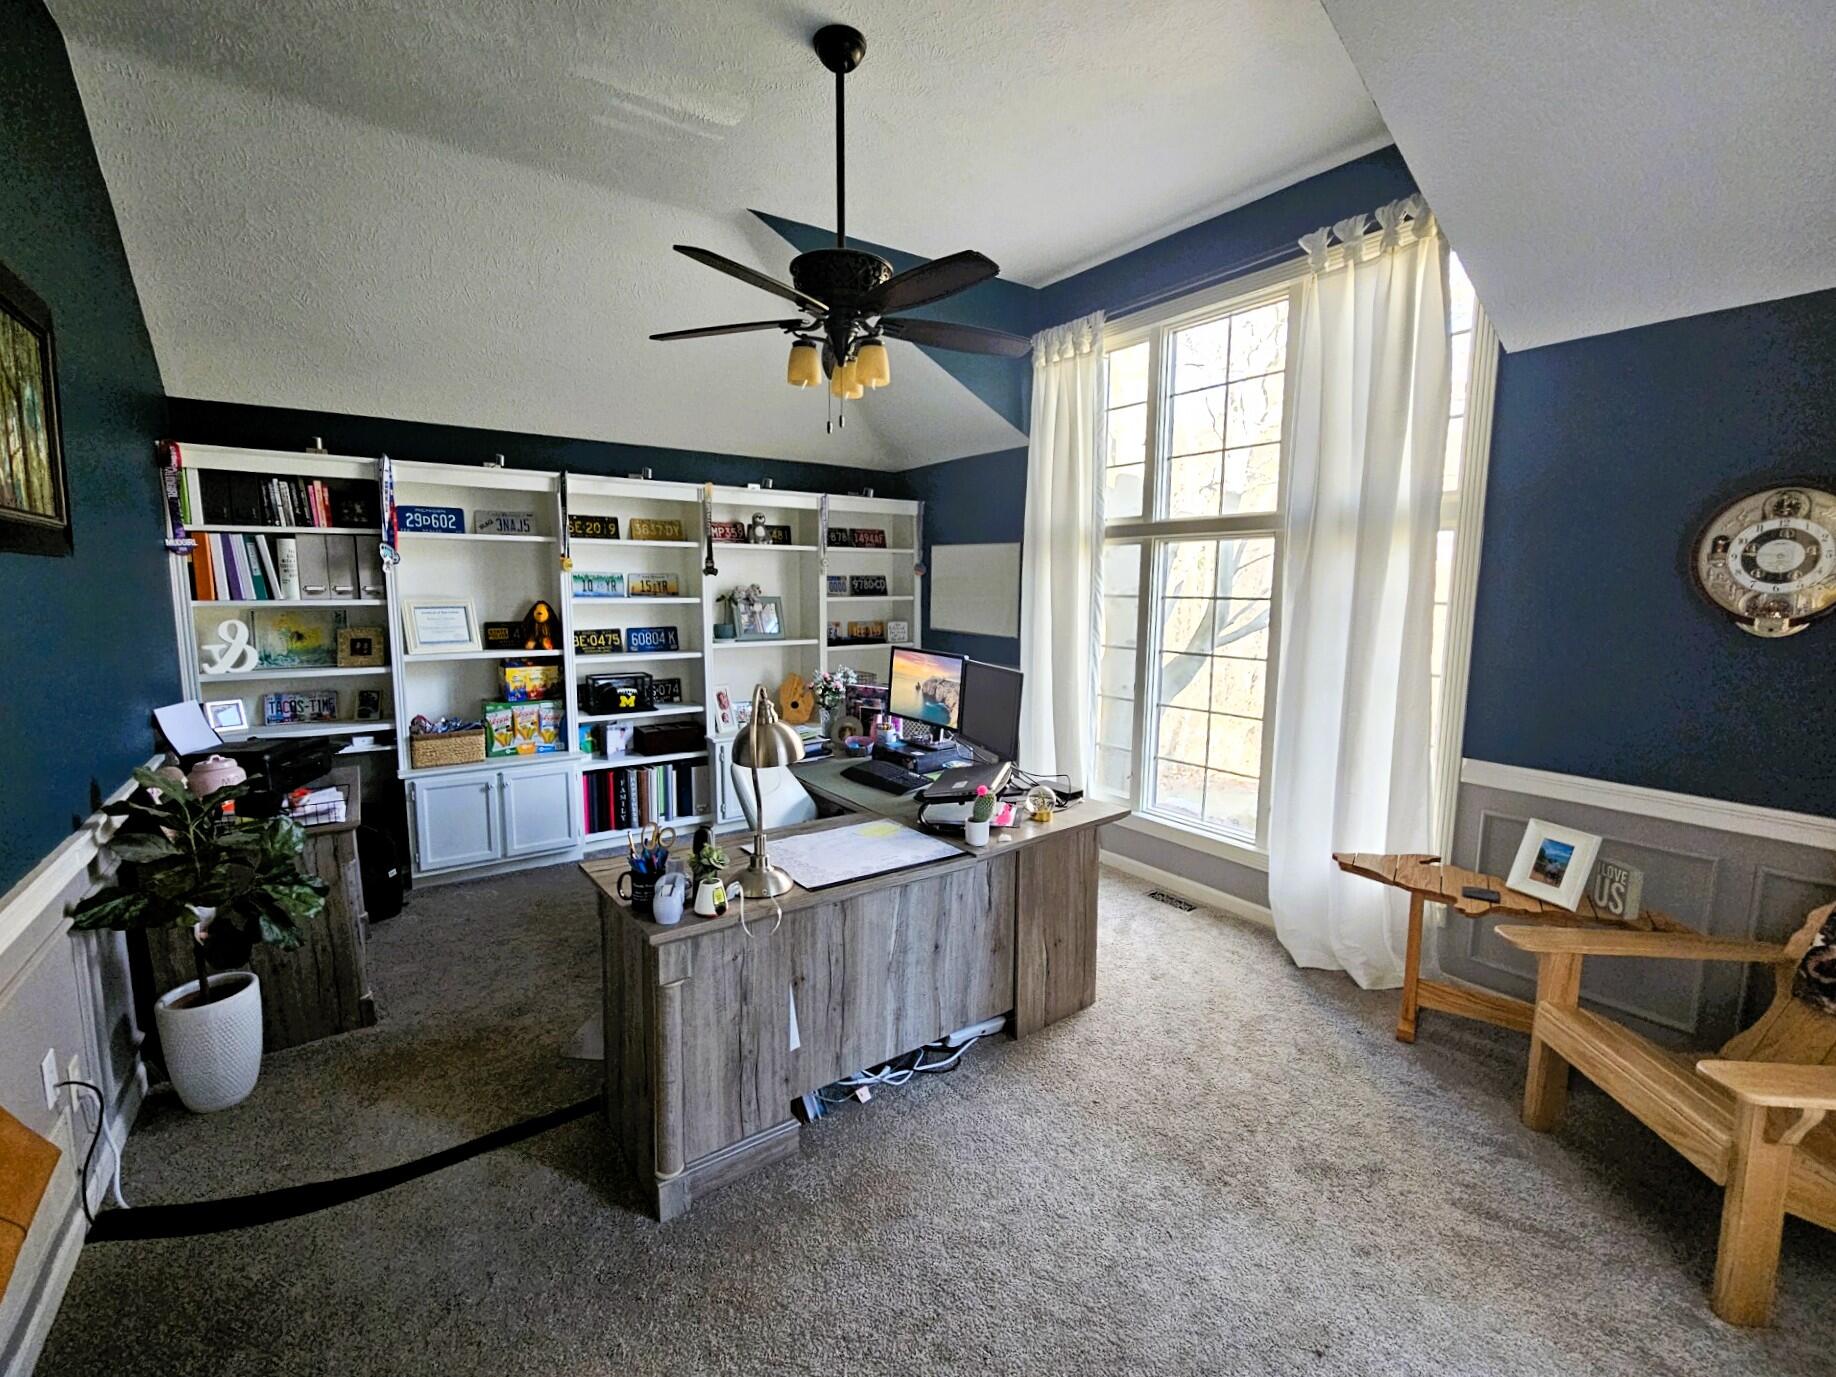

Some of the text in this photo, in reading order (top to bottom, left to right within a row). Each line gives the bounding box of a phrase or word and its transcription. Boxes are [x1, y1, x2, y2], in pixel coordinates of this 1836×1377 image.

[405, 512, 457, 529] 29D602
[631, 630, 676, 646] 60804 K
[618, 695, 636, 708] M
[1602, 862, 1629, 886] LOVE
[1594, 874, 1625, 915] US
